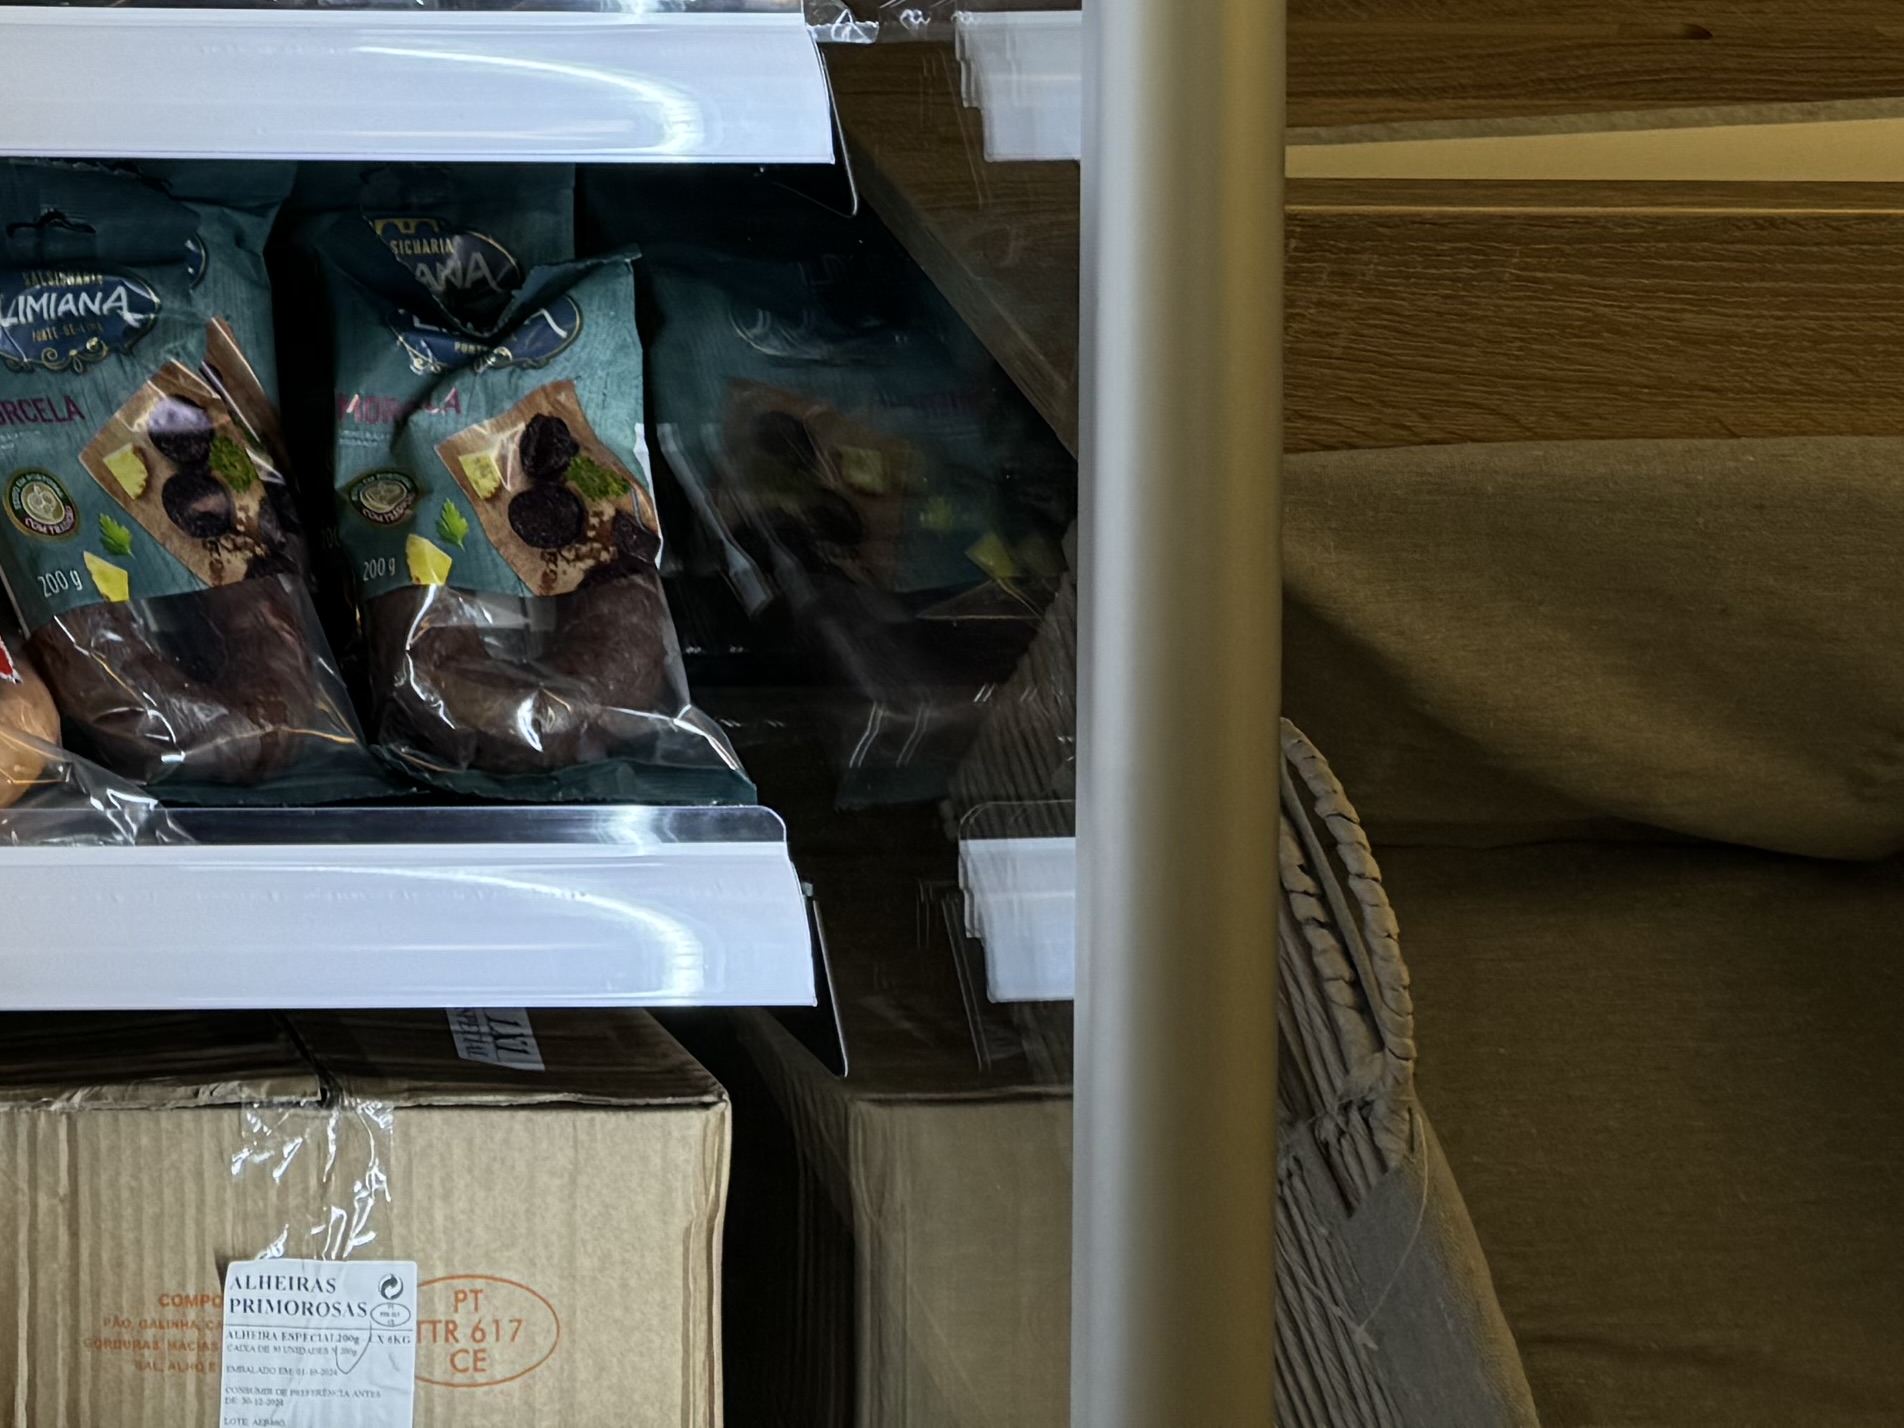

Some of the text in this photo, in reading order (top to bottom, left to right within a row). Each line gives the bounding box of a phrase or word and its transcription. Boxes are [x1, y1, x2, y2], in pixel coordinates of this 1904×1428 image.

[362, 558, 386, 581] 200
[38, 570, 70, 598] 200
[228, 1274, 337, 1295] ALHEIRAS
[228, 1297, 369, 1319] PRIMOROSAS
[452, 1288, 484, 1314] PT
[225, 1329, 278, 1343] ALHEIRA
[470, 1318, 525, 1344] 617
[449, 1349, 487, 1374] CE
